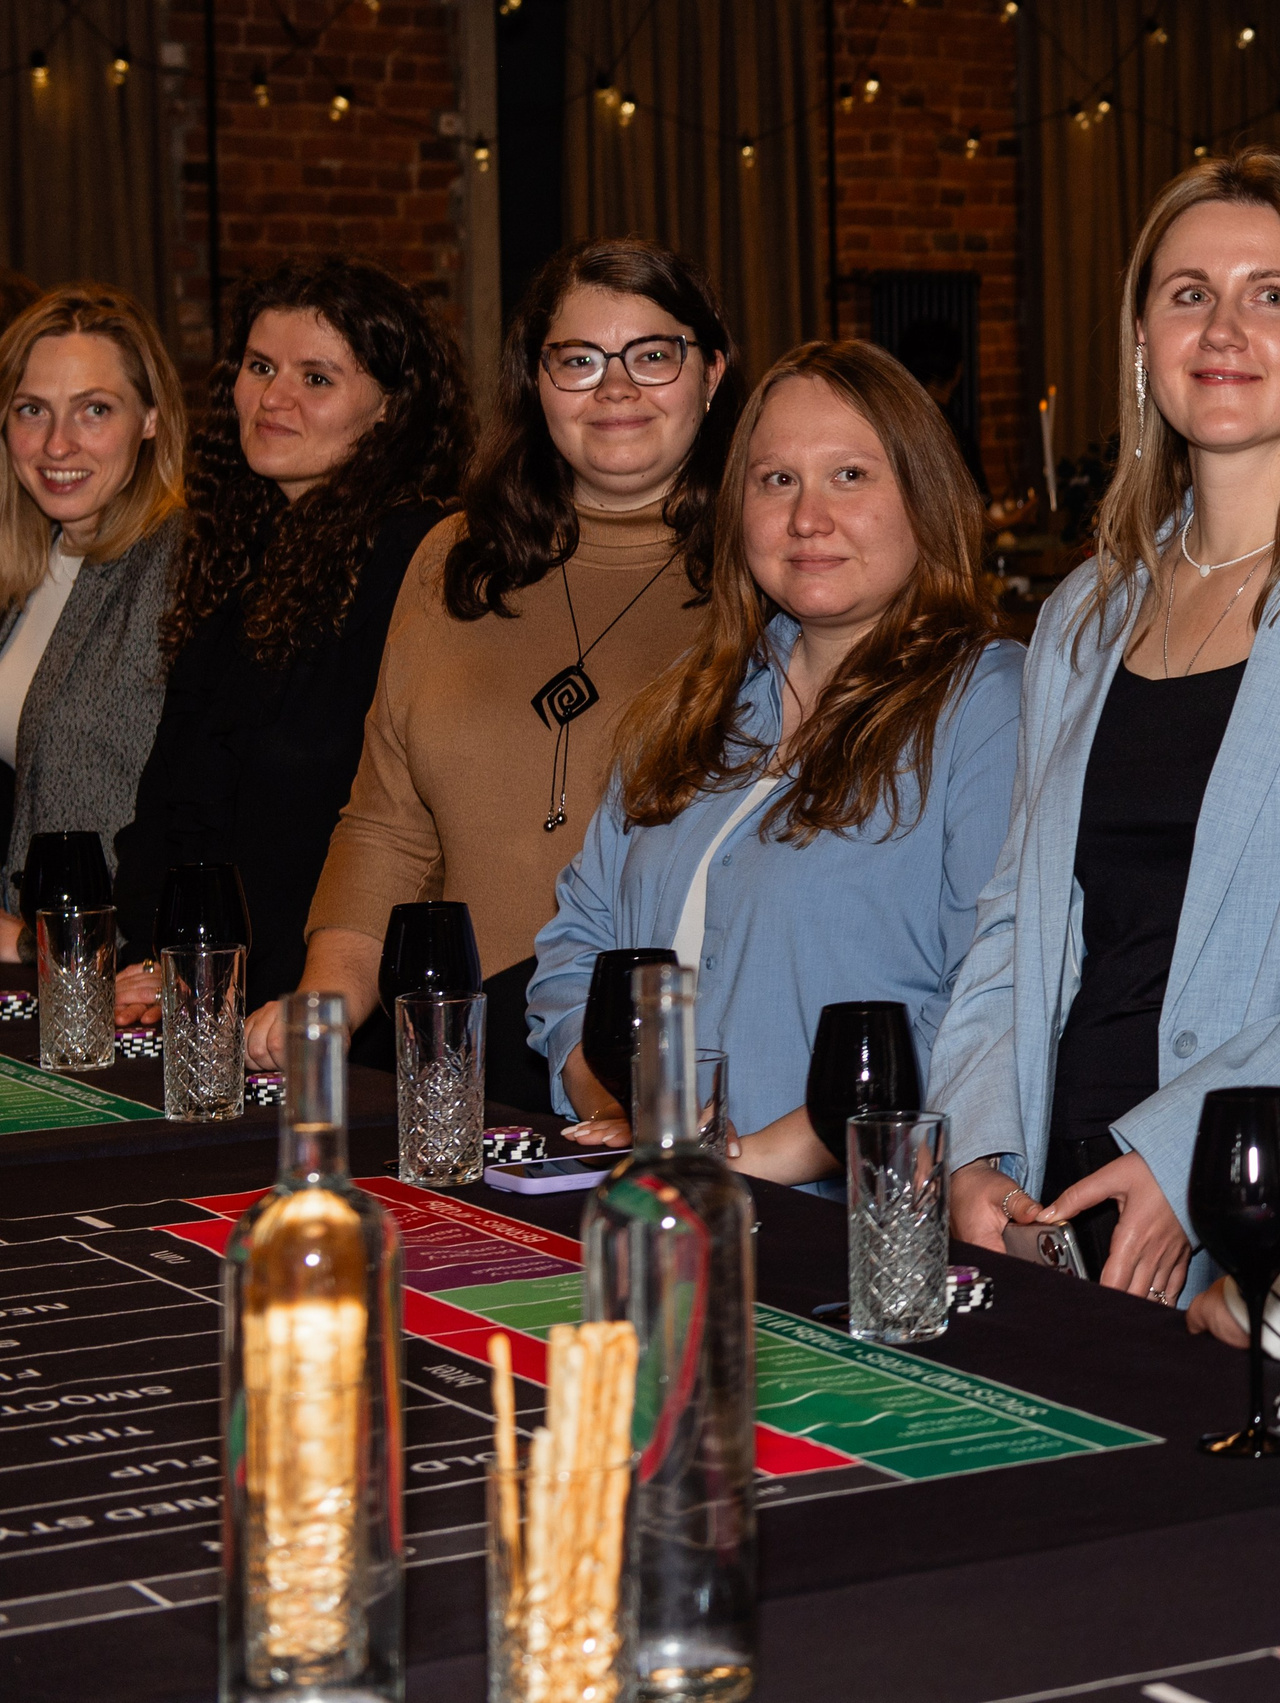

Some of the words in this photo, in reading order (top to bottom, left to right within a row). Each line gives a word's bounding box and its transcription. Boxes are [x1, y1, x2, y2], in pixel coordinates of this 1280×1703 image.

[149, 1250, 191, 1264] rum
[0, 1303, 70, 1317] NE
[422, 1363, 487, 1388] bitter
[50, 1426, 155, 1447] TINI
[110, 1455, 220, 1478] FLIP
